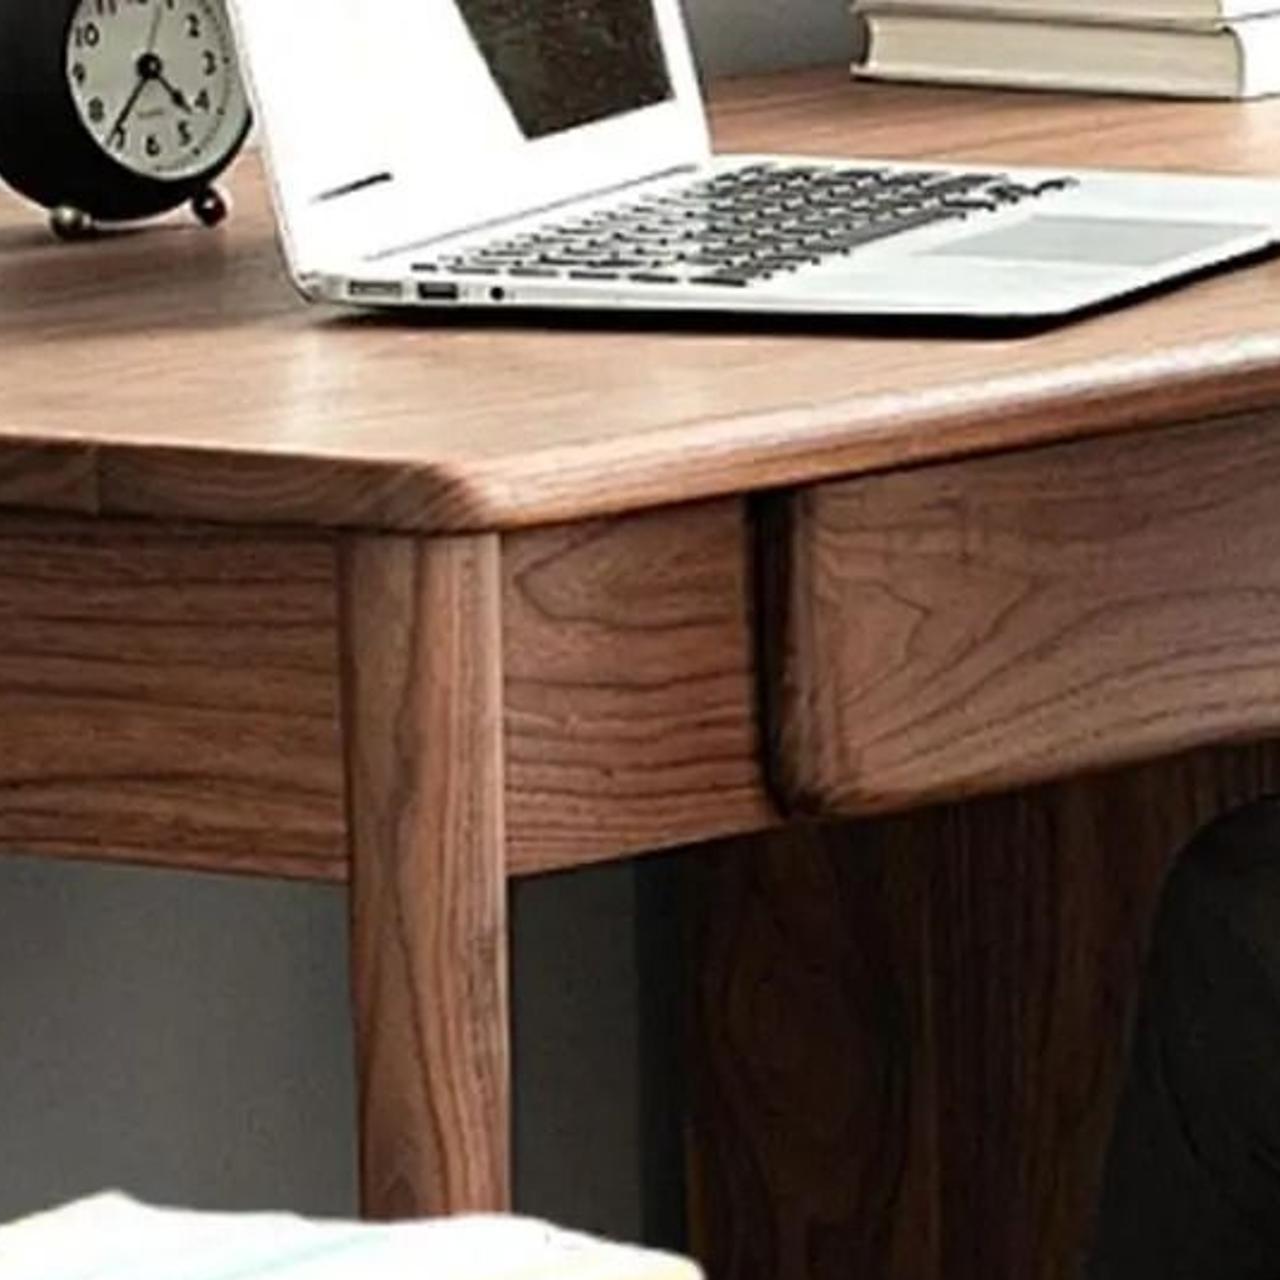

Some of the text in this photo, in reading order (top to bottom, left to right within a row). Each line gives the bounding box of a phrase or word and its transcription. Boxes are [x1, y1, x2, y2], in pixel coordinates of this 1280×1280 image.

[75, 22, 99, 46] 10
[186, 12, 200, 38] 2
[202, 50, 217, 75] 3
[194, 87, 210, 113] 4
[146, 134, 160, 156] 6
[178, 121, 191, 147] 5
